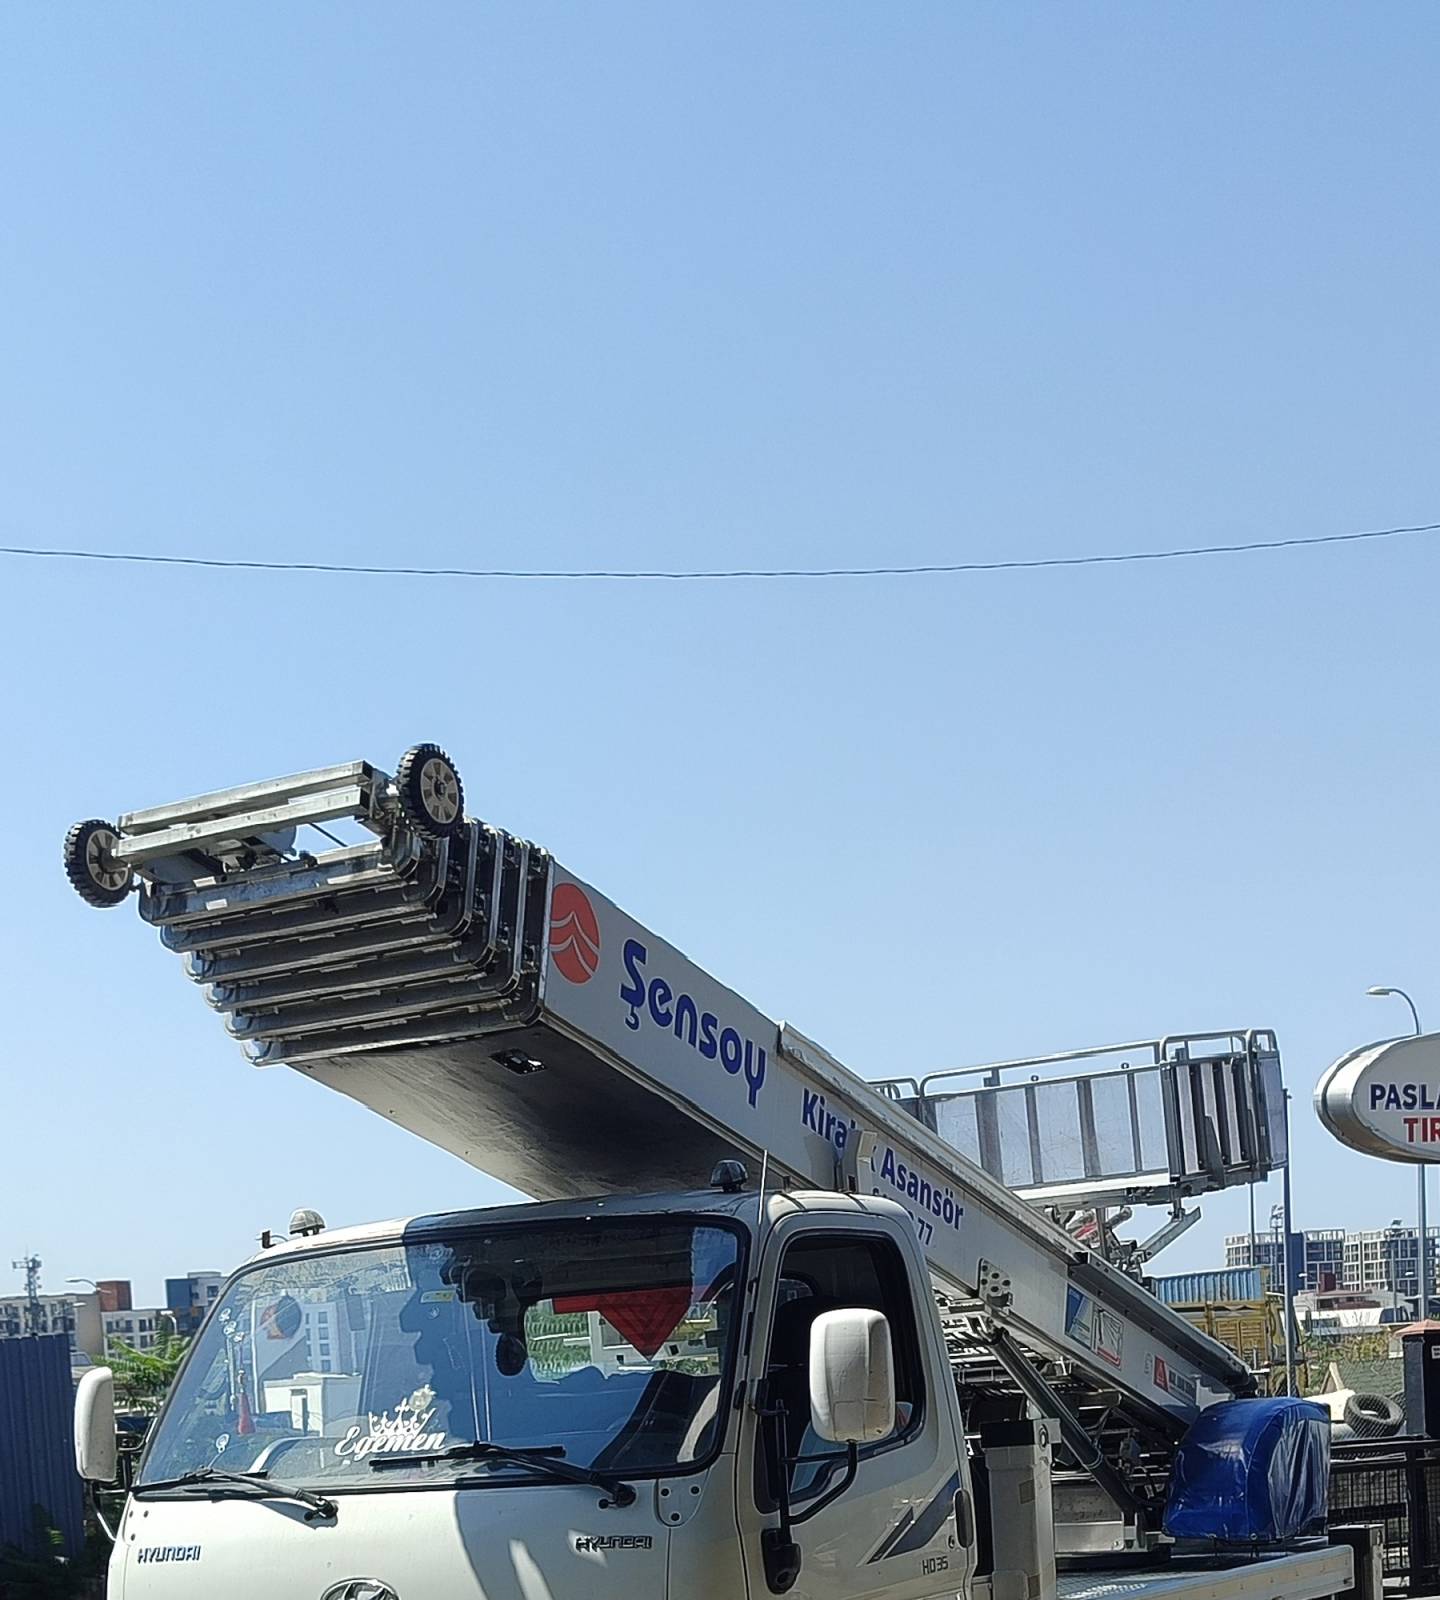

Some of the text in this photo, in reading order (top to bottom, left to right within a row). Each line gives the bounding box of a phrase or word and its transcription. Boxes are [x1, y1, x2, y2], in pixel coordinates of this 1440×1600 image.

[619, 938, 767, 1109] Şensoy
[1369, 1084, 1440, 1110] PASL
[880, 1147, 964, 1231] Asansör
[334, 1426, 446, 1461] Egemen
[137, 1545, 202, 1564] HYUNDAI
[575, 1535, 654, 1553] HYUNDAI
